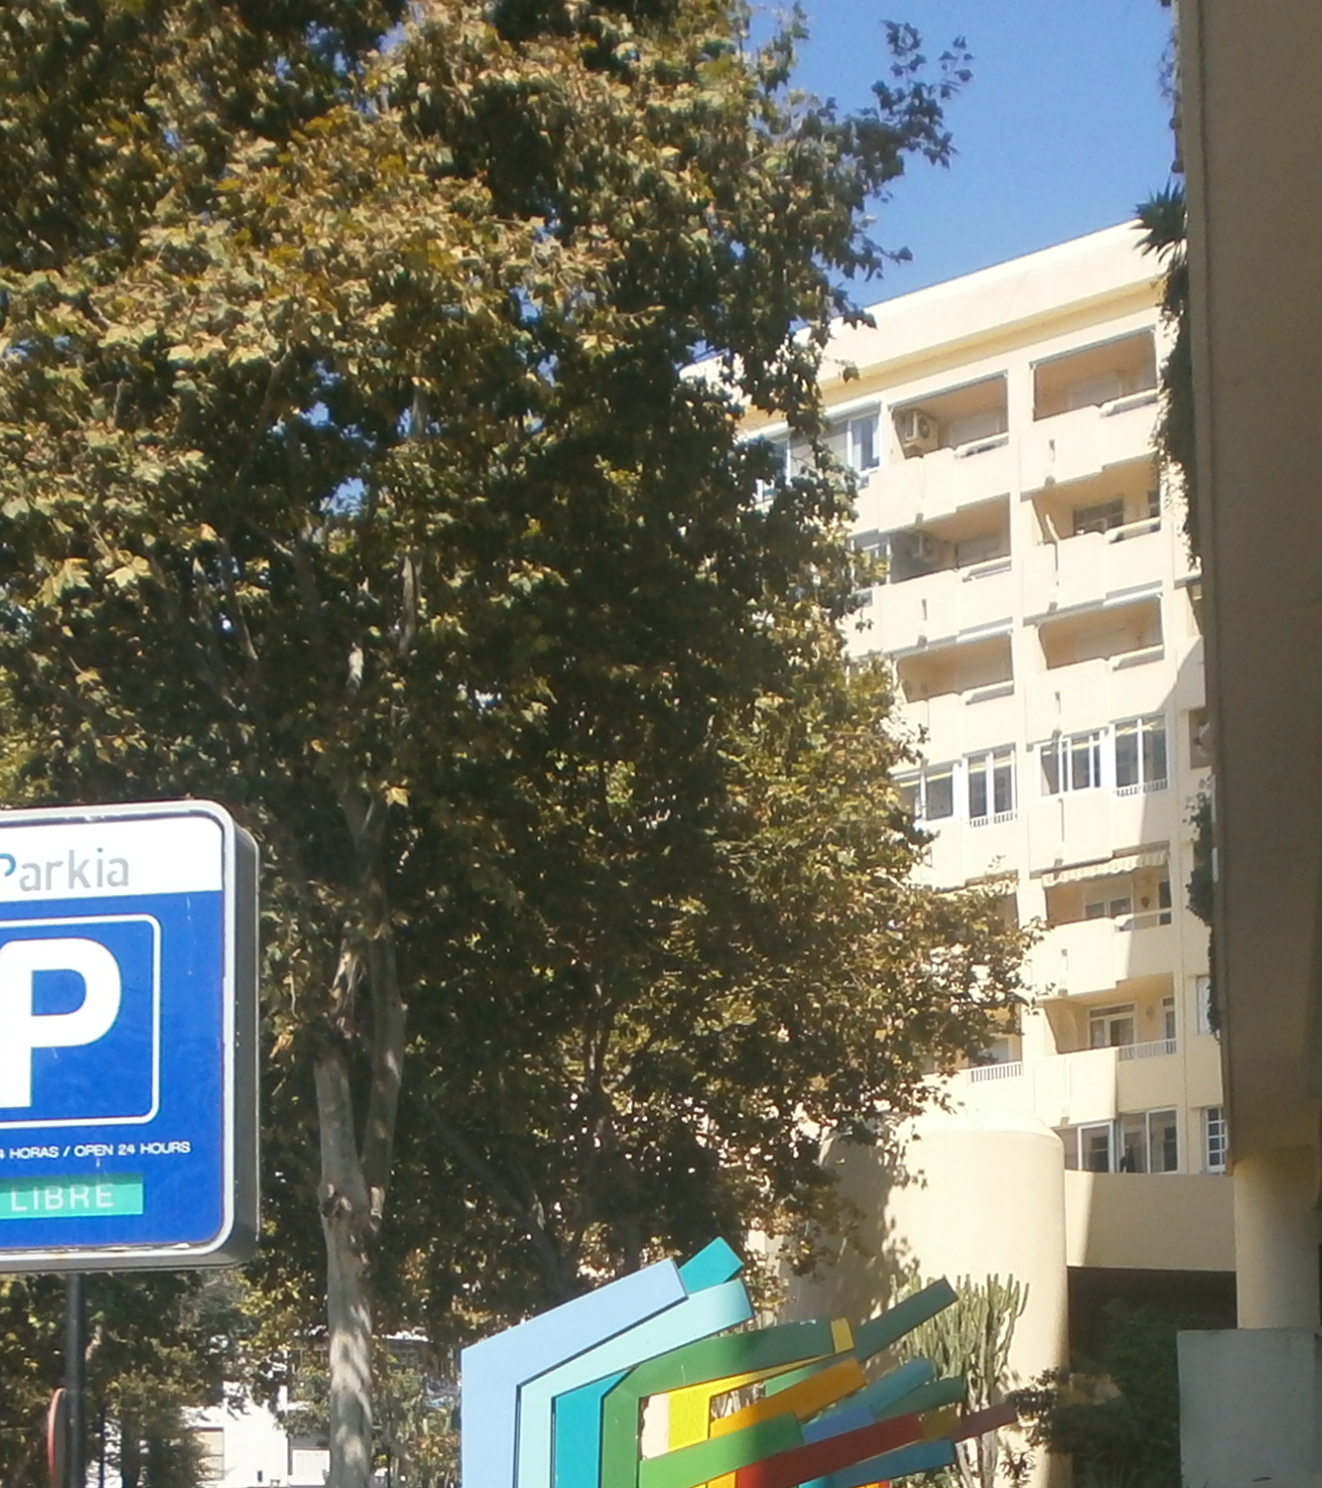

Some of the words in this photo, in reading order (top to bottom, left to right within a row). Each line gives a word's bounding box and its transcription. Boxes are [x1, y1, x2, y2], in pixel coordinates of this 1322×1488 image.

[9, 1146, 59, 1160] HORAS
[62, 1145, 70, 1158] /
[73, 1144, 114, 1158] OPEN
[117, 1143, 135, 1156] 24
[140, 1141, 191, 1155] HOURS
[10, 1183, 115, 1212] LIBRE
